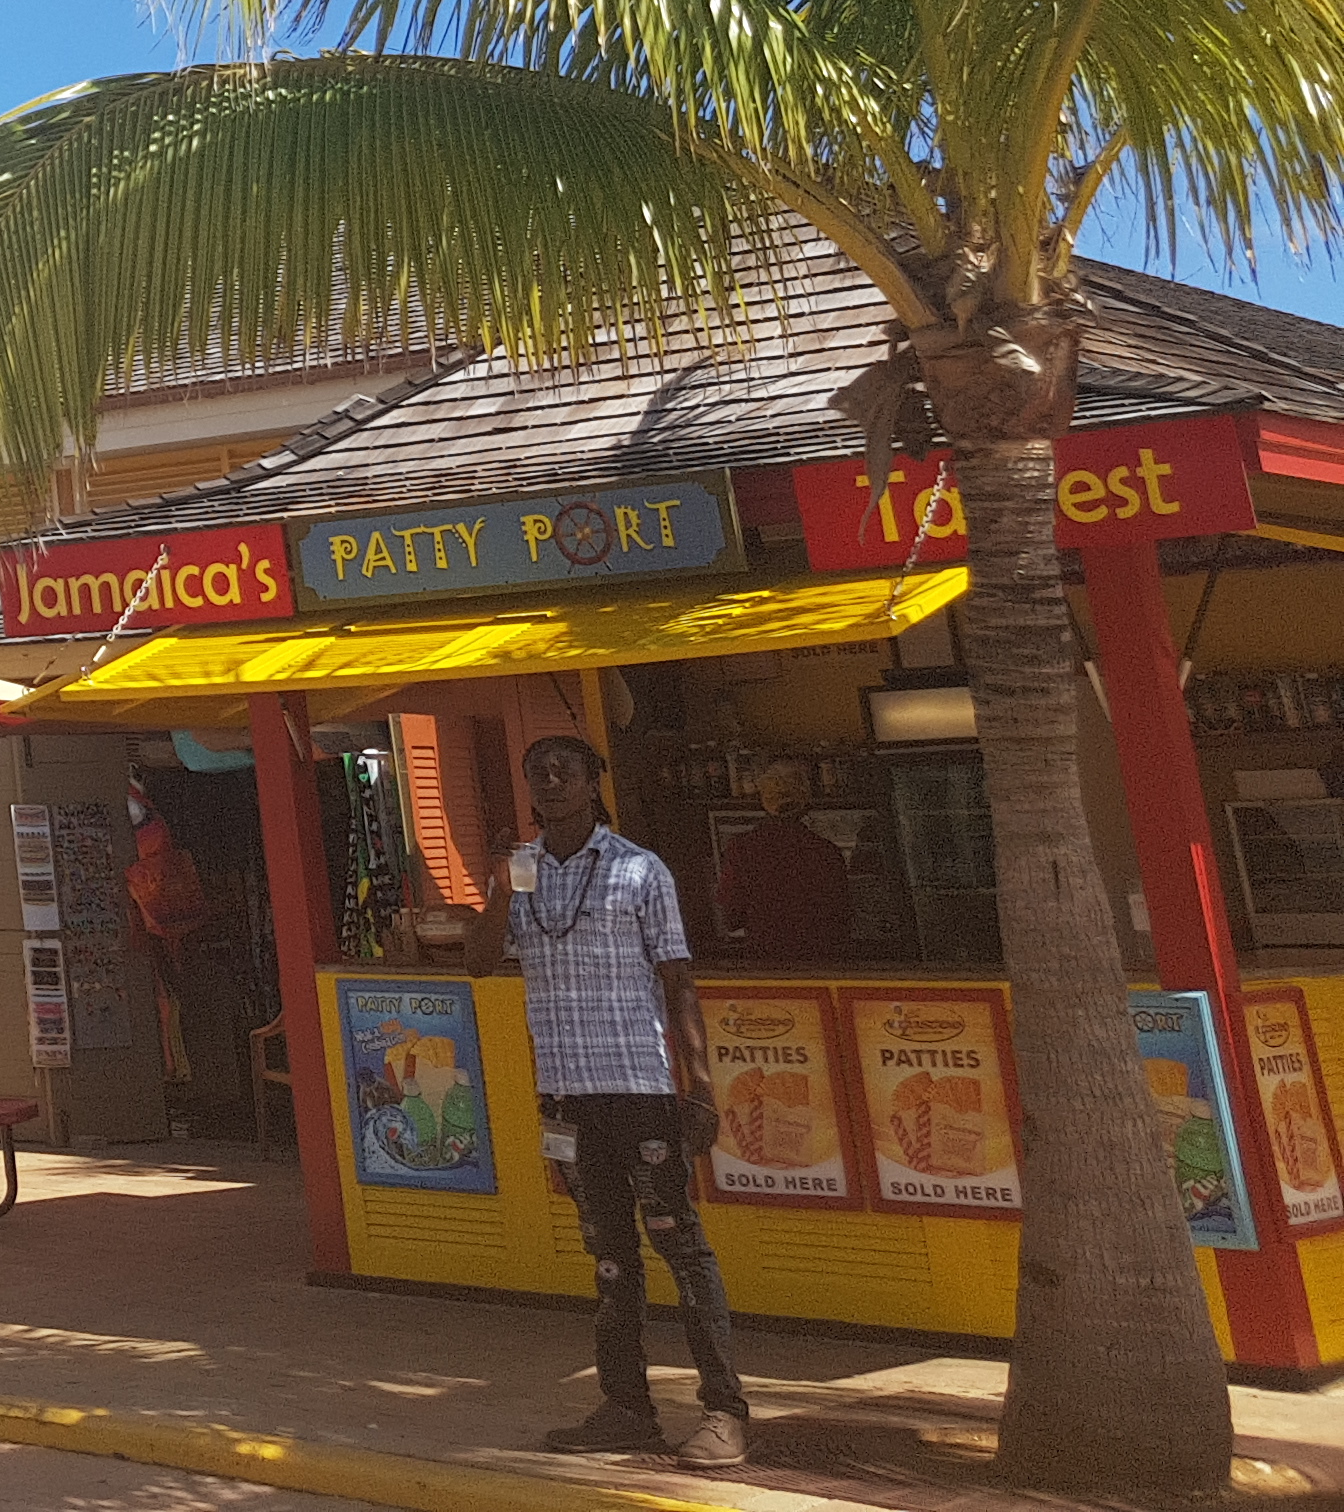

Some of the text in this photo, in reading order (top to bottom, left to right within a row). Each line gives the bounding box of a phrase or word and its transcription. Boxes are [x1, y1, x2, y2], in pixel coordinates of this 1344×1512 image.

[855, 448, 1180, 544] Taest
[328, 499, 681, 581] PATTY PORT
[16, 541, 277, 625] Jamaica's
[355, 995, 403, 1013] PATTY
[716, 1044, 809, 1065] PATTIES
[879, 1047, 982, 1069] PATTIES
[1258, 1052, 1304, 1077] PATTIES
[724, 1172, 839, 1193] SOLD HERE
[889, 1180, 1014, 1203] SOLD HERE
[1286, 1194, 1340, 1220] SOLD HERE
